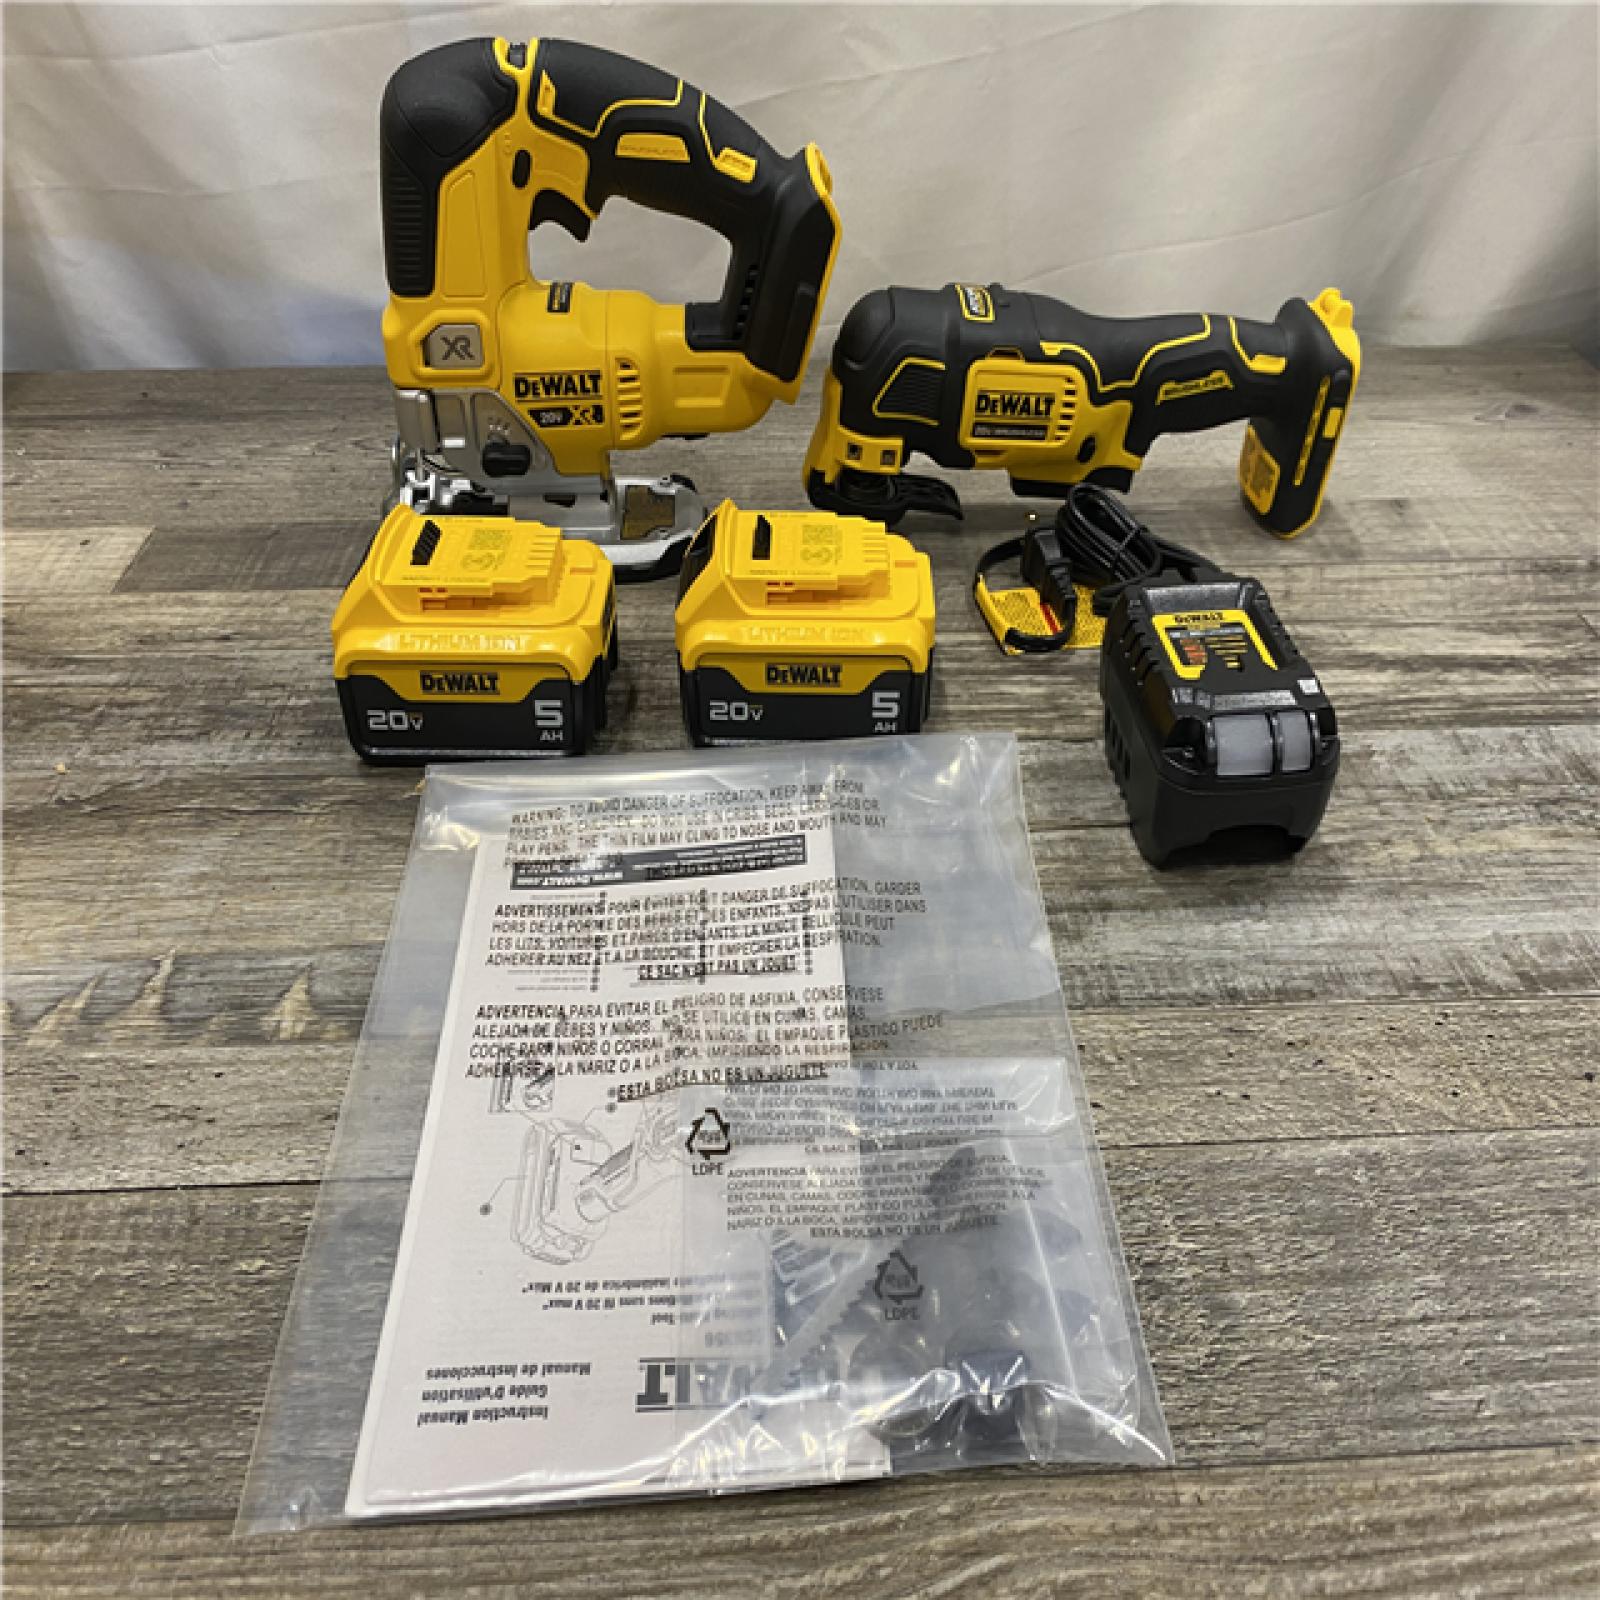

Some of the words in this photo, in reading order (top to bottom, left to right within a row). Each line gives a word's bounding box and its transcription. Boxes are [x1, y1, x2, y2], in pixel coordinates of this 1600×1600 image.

[440, 335, 475, 361] XR
[514, 373, 602, 398] DEWALT
[976, 393, 1056, 416] DEWALT
[420, 673, 499, 693] DEWALT
[766, 665, 842, 686] DEWALT
[534, 699, 563, 727] 5
[872, 692, 900, 719] 5
[623, 795, 667, 811] DANGER
[835, 779, 864, 794] FROM
[659, 829, 683, 844] MAY
[875, 881, 922, 896] GARDER
[895, 899, 927, 914] DANS
[569, 1003, 601, 1017] PARA
[617, 1083, 650, 1102] ESTA
[541, 1362, 591, 1376] Manual
[509, 1384, 548, 1399] Guide
[416, 1409, 468, 1428] Manual
[472, 1404, 548, 1423] Instruction
